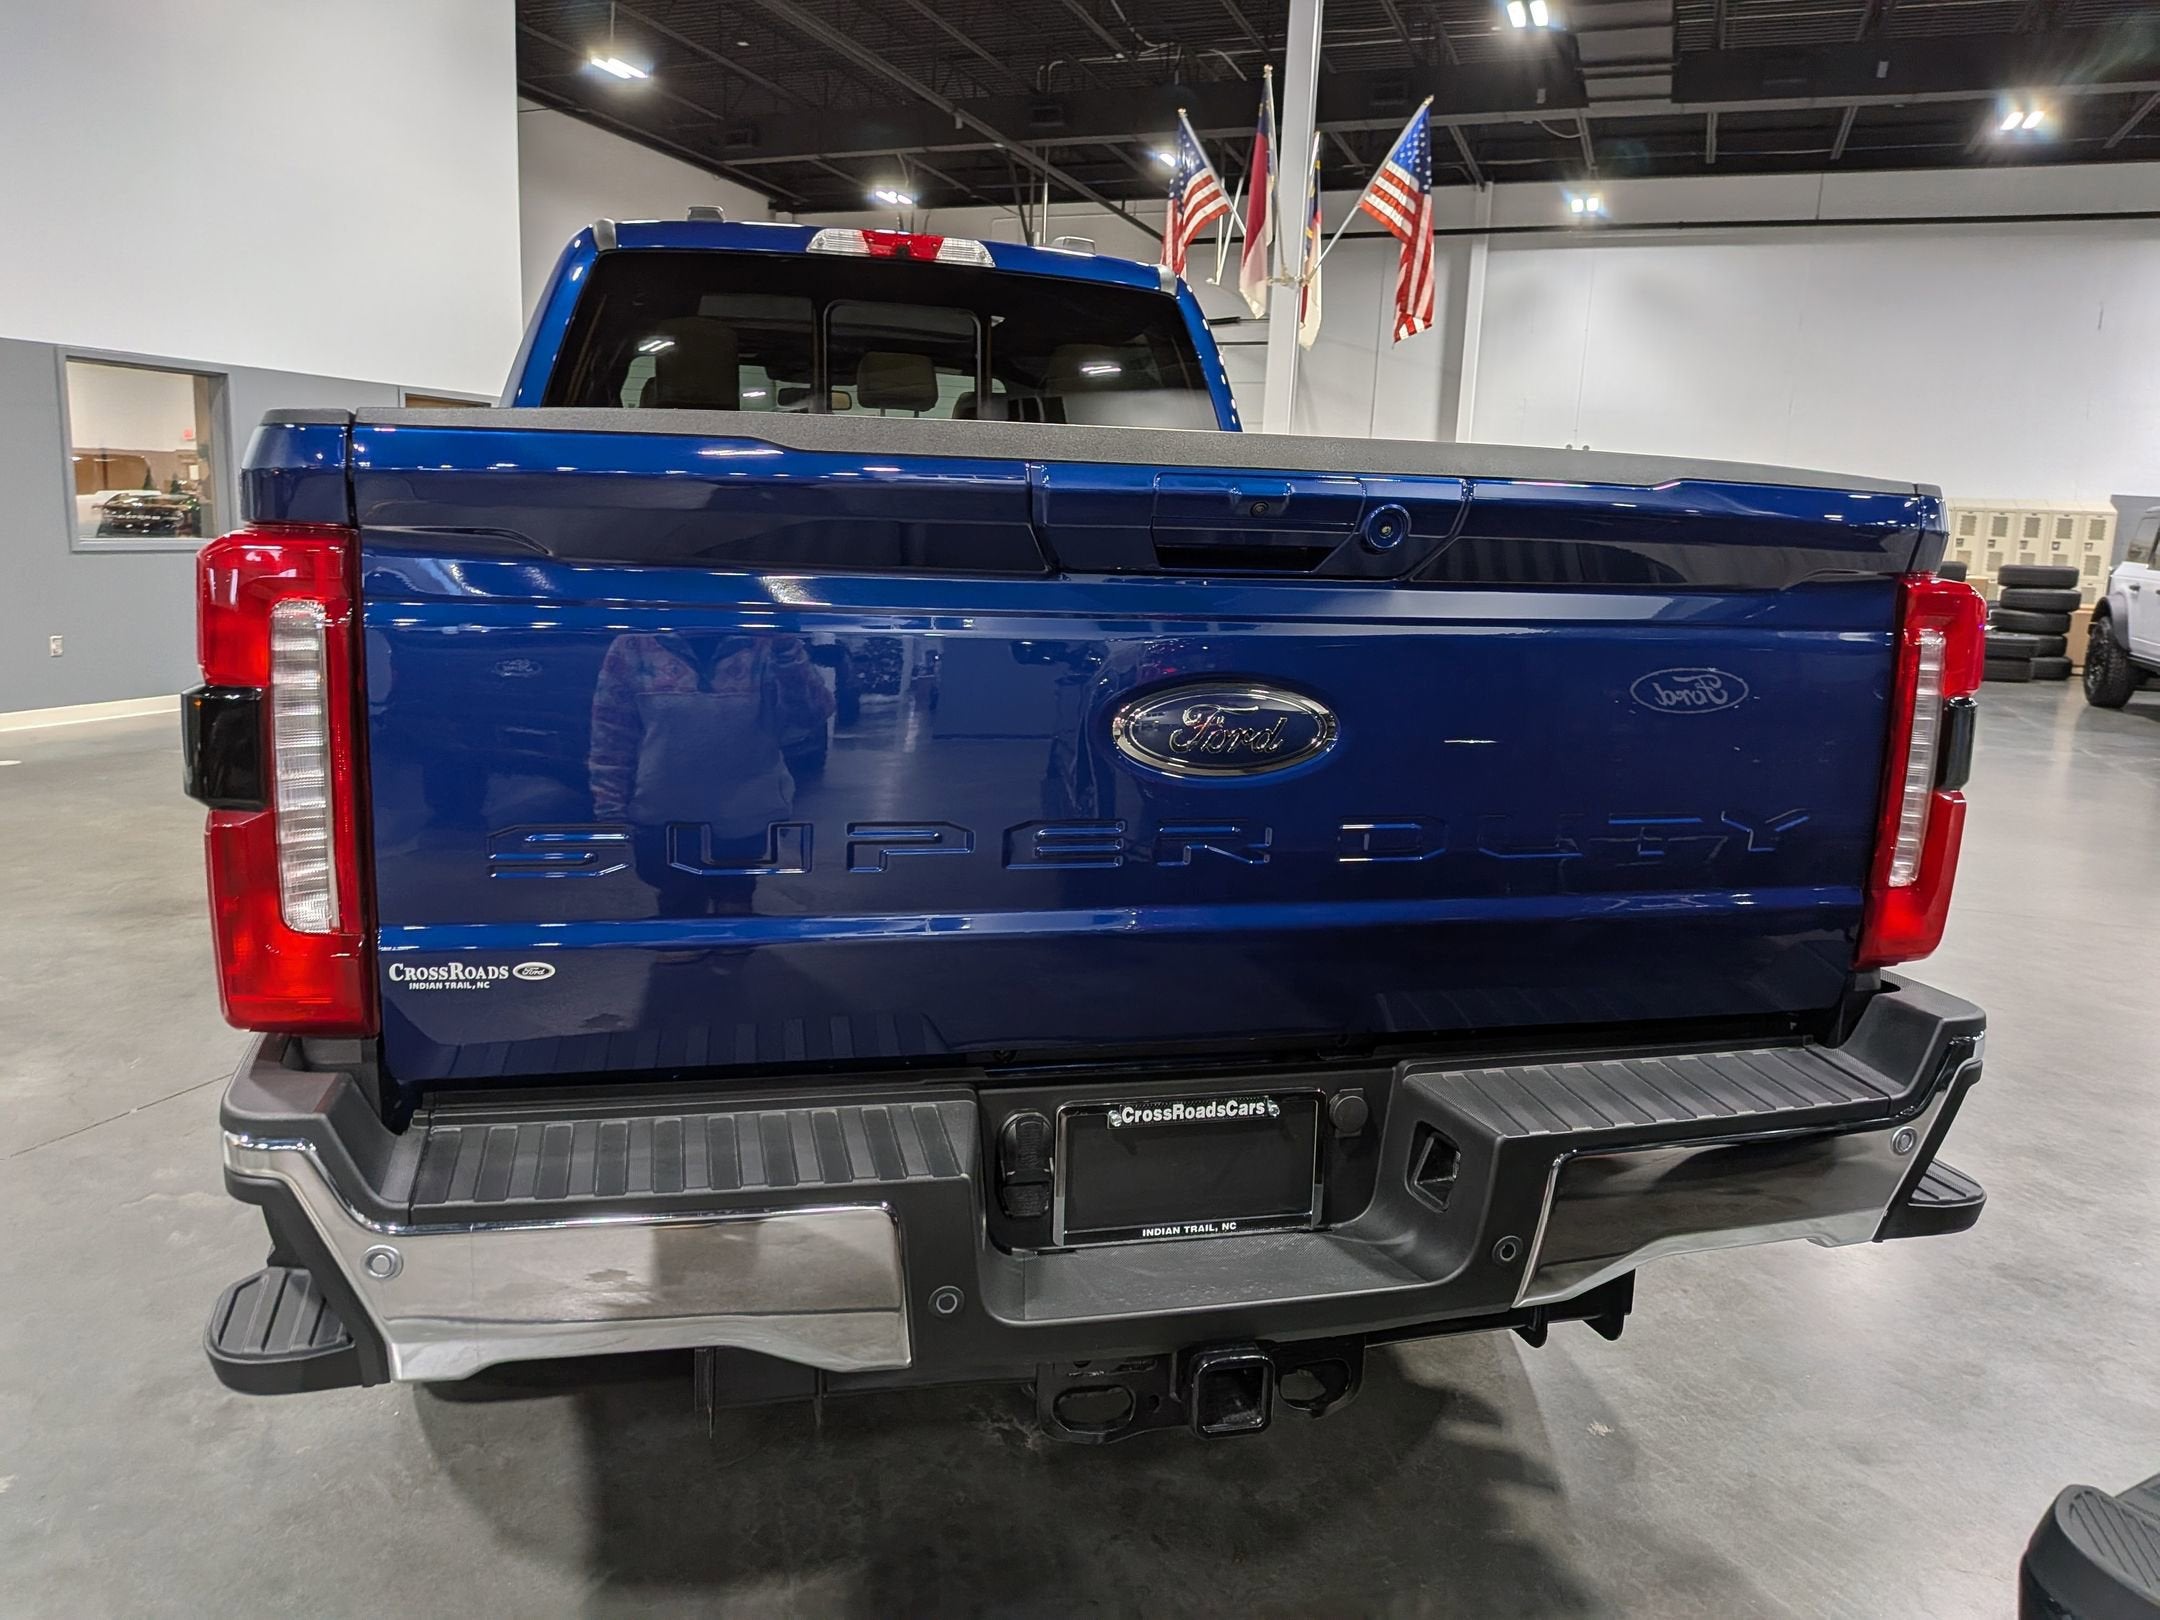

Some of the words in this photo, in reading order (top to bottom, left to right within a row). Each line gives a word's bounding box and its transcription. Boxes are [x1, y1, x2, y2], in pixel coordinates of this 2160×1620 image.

[1168, 703, 1288, 754] Ford
[486, 816, 1273, 879] SUPER
[1335, 806, 1811, 863] DUTY
[521, 967, 546, 976] Ford
[408, 981, 443, 990] INDIAN
[476, 981, 490, 989] NC
[1122, 1100, 1265, 1123] CrossRoadsCars
[1142, 1226, 1181, 1237] INDIAN
[1183, 1223, 1219, 1234] TRAIL,
[1221, 1221, 1237, 1231] NC
